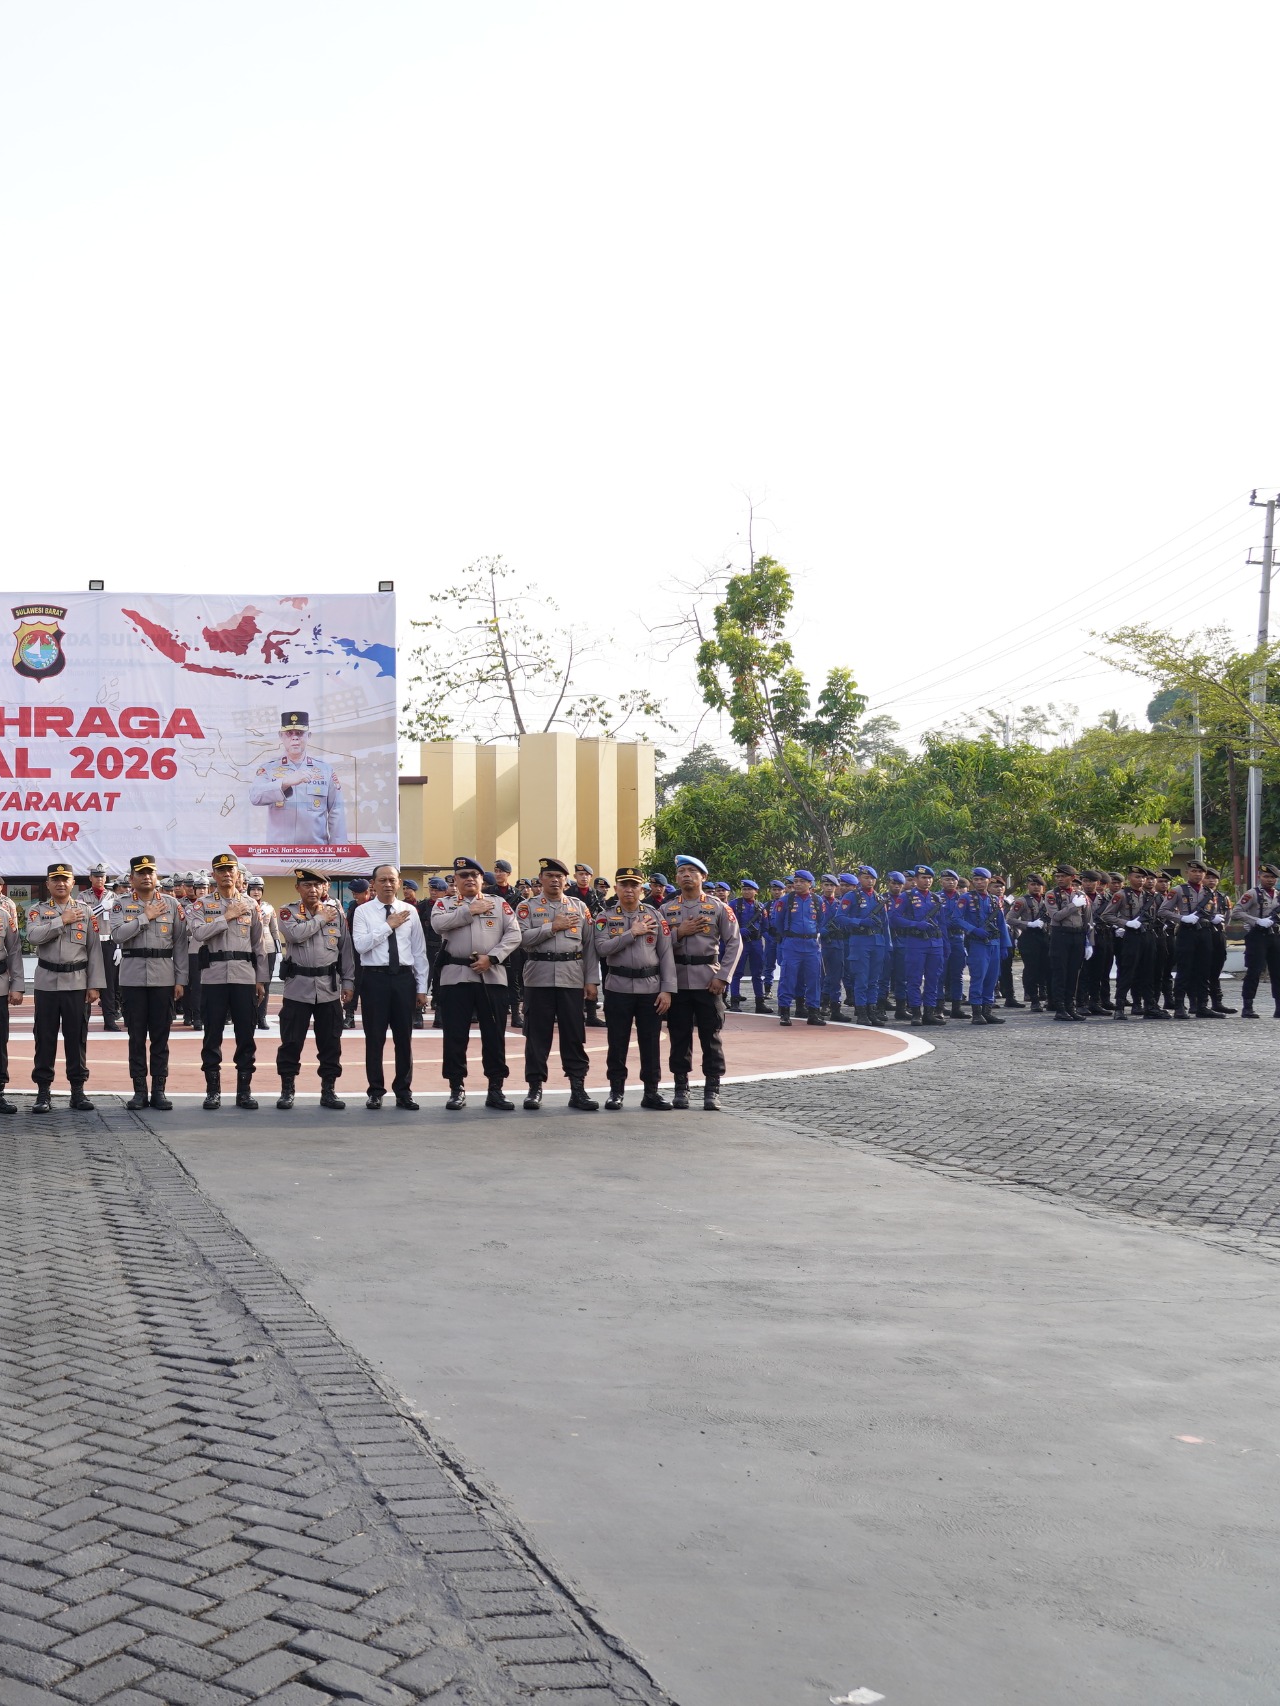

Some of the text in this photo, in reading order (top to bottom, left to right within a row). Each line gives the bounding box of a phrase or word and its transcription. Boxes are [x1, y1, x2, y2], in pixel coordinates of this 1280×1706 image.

[15, 607, 64, 617] SULAWESI BARAT
[70, 747, 178, 780] 2026
